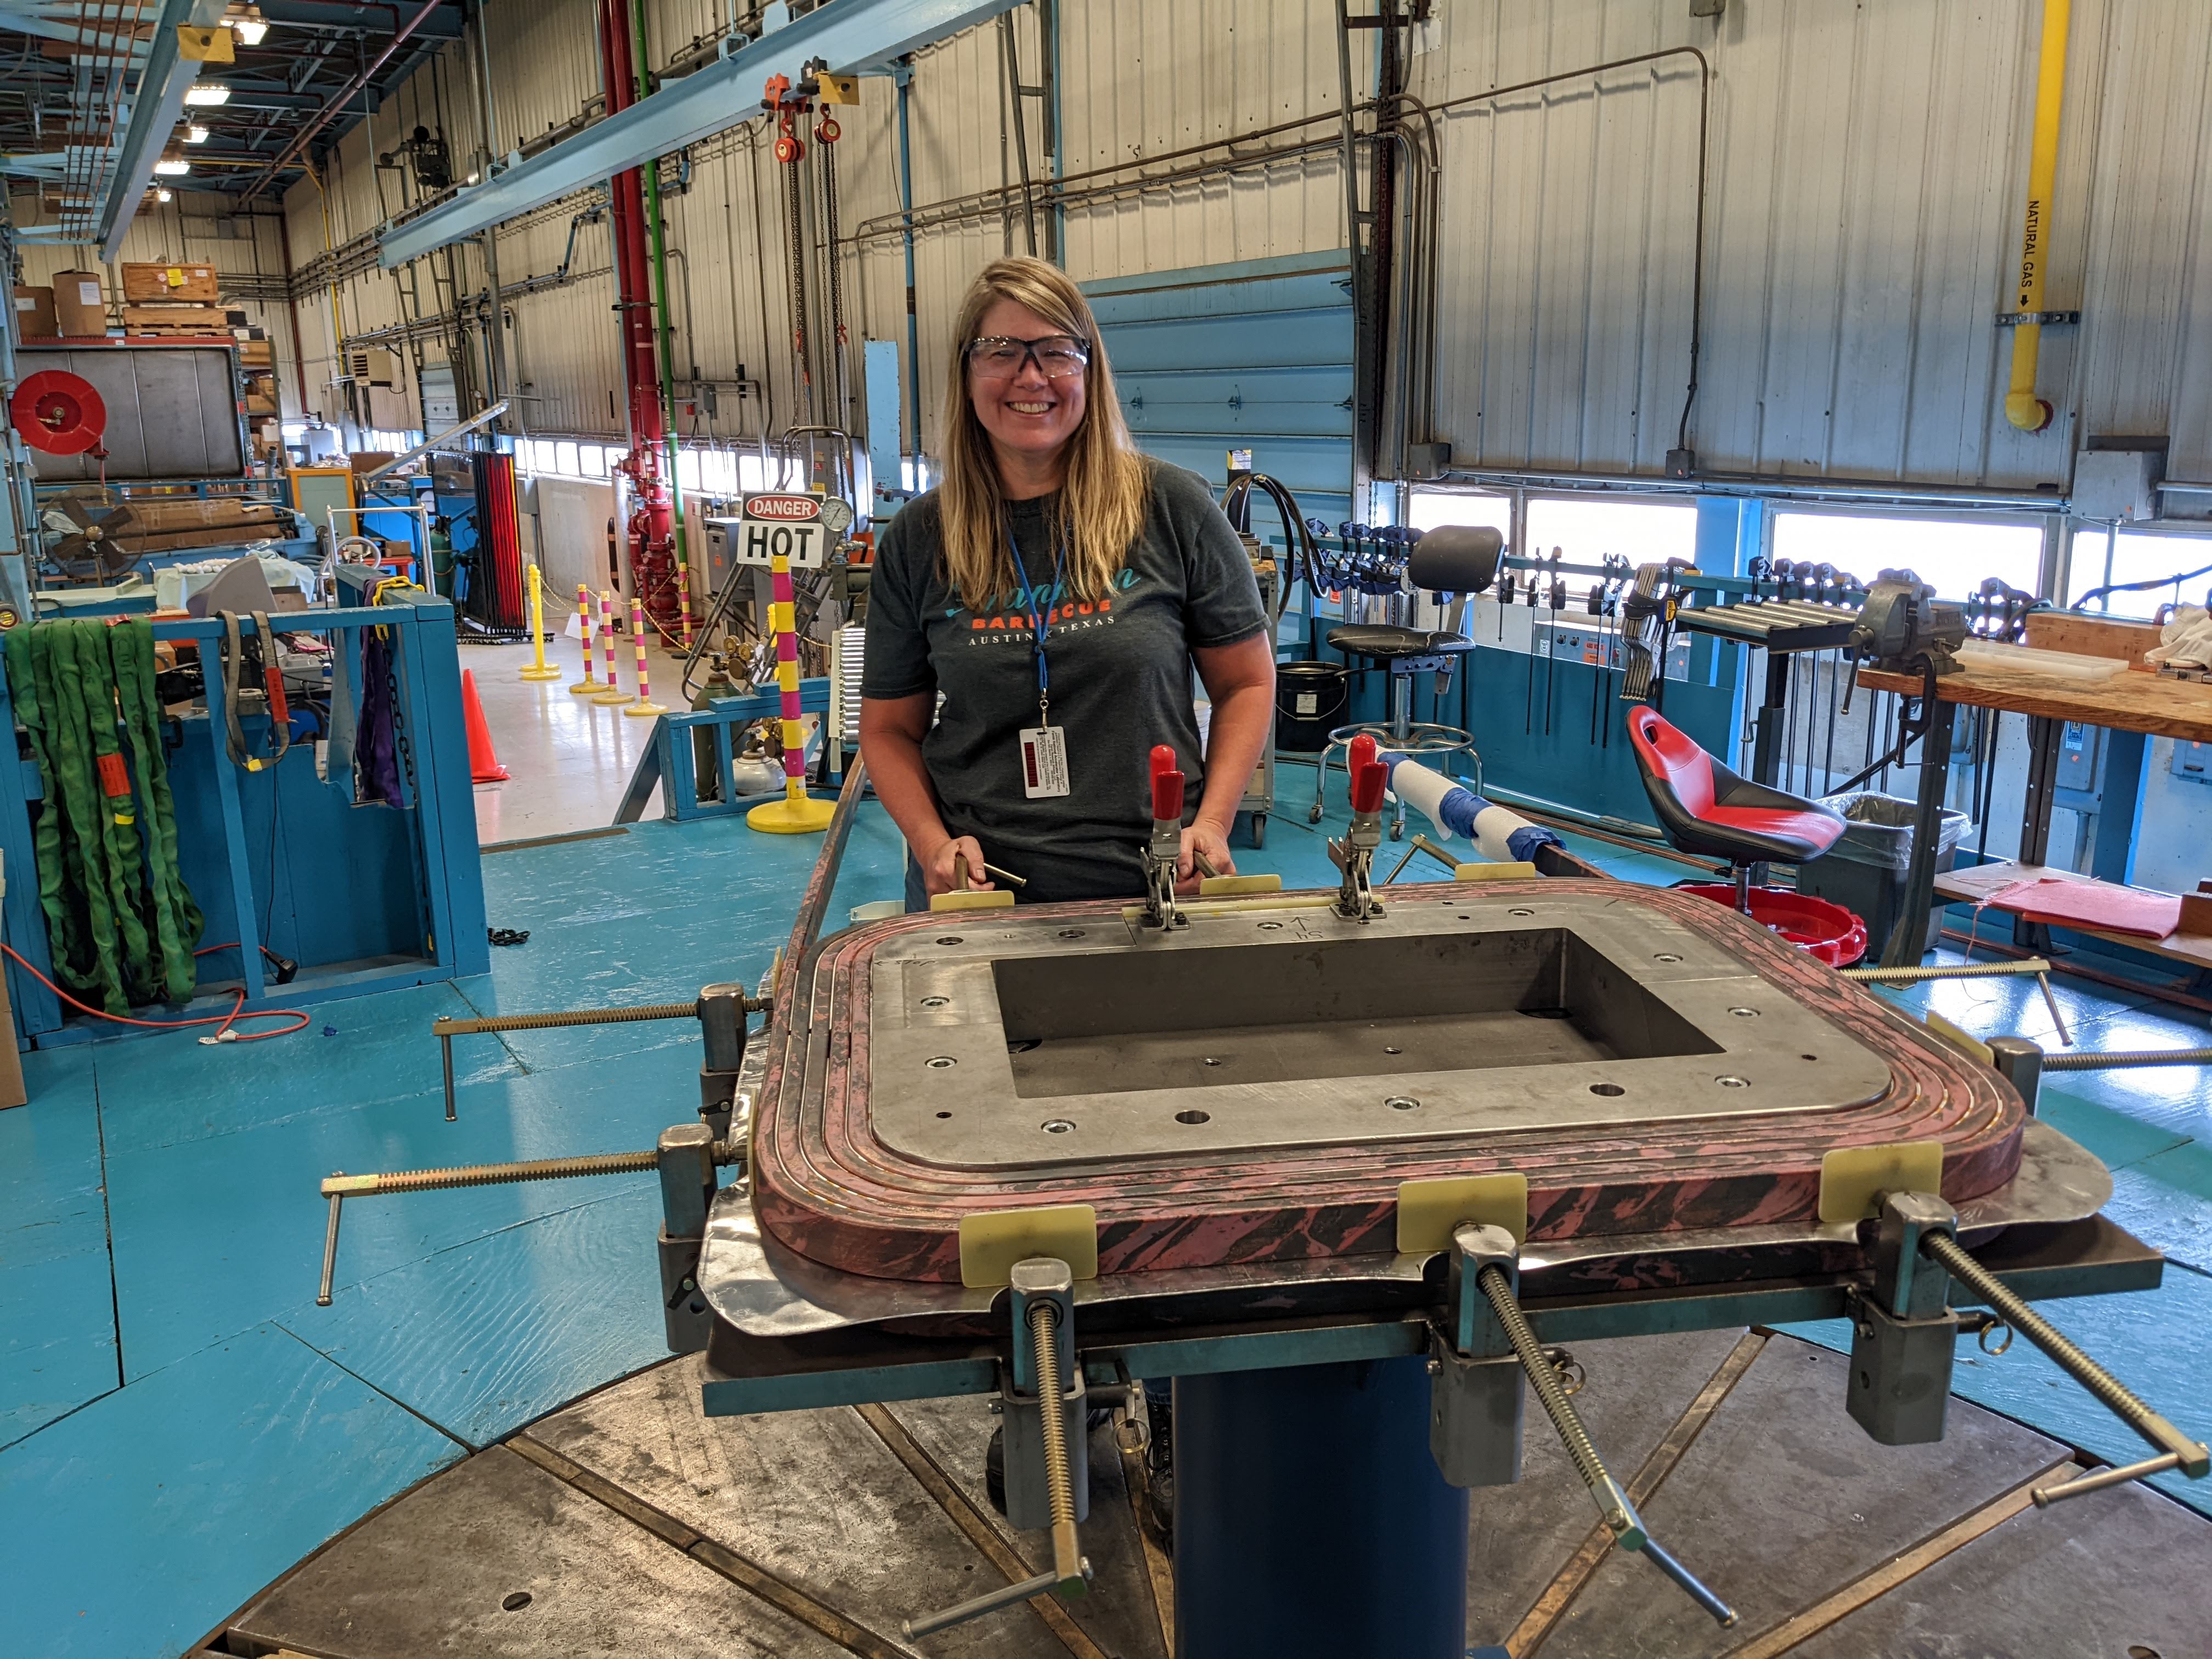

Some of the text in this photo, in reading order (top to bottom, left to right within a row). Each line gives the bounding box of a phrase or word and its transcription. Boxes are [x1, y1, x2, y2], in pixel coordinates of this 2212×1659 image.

[2022, 200, 2039, 287] NATURAL GAS
[754, 500, 812, 516] DANGER
[747, 526, 814, 561] HOT
[968, 616, 1115, 646] AUSTIN TEXAS
